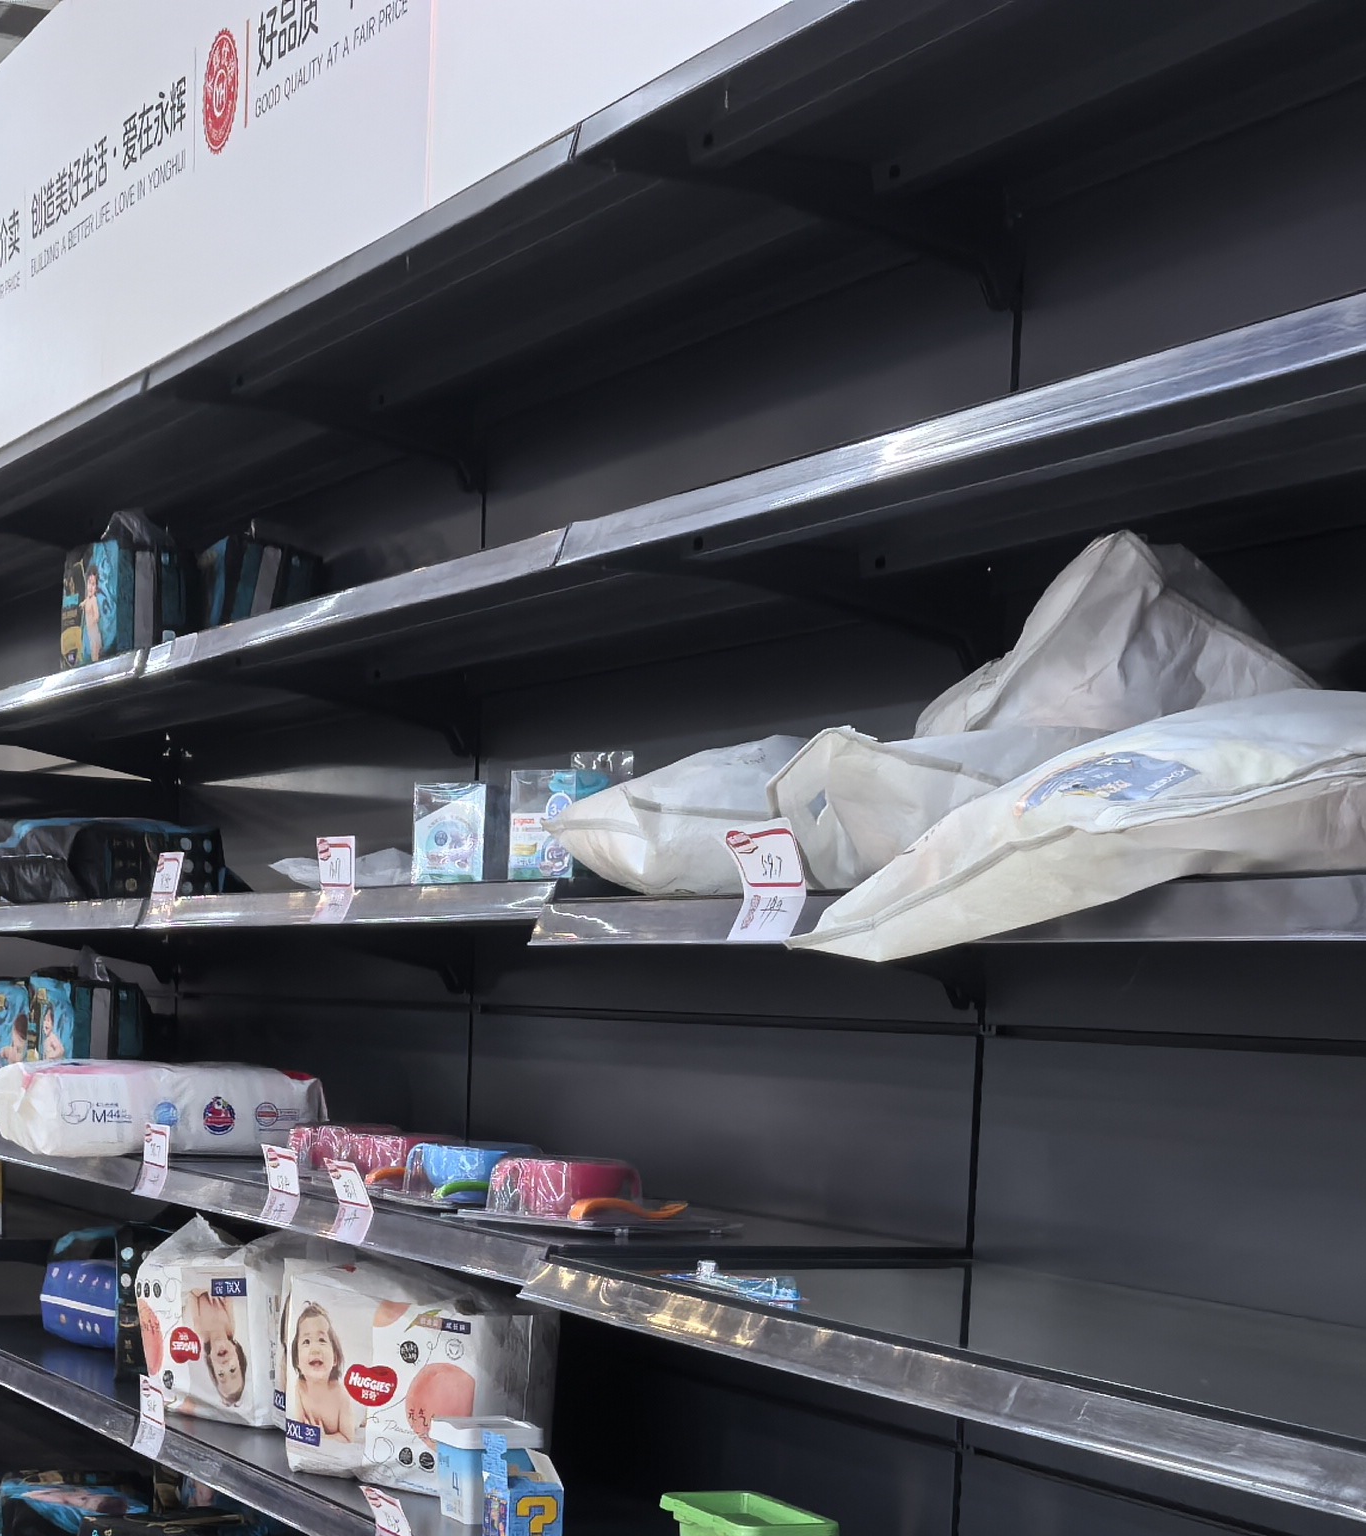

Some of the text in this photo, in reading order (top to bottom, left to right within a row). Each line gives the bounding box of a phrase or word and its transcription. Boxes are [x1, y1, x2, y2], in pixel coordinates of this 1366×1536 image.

[255, 0, 408, 118] GOOD QUALITY AT A FAIR PRICE
[31, 241, 59, 277] BUILDING
[61, 235, 67, 255] A
[68, 213, 94, 250] BETTER
[114, 184, 135, 217] LOVE
[137, 178, 146, 201] IN
[147, 149, 186, 190] YONGHUI
[172, 1341, 198, 1355] HUGGIES
[349, 1371, 391, 1393] HUGGIES
[287, 1422, 303, 1440] XXL
